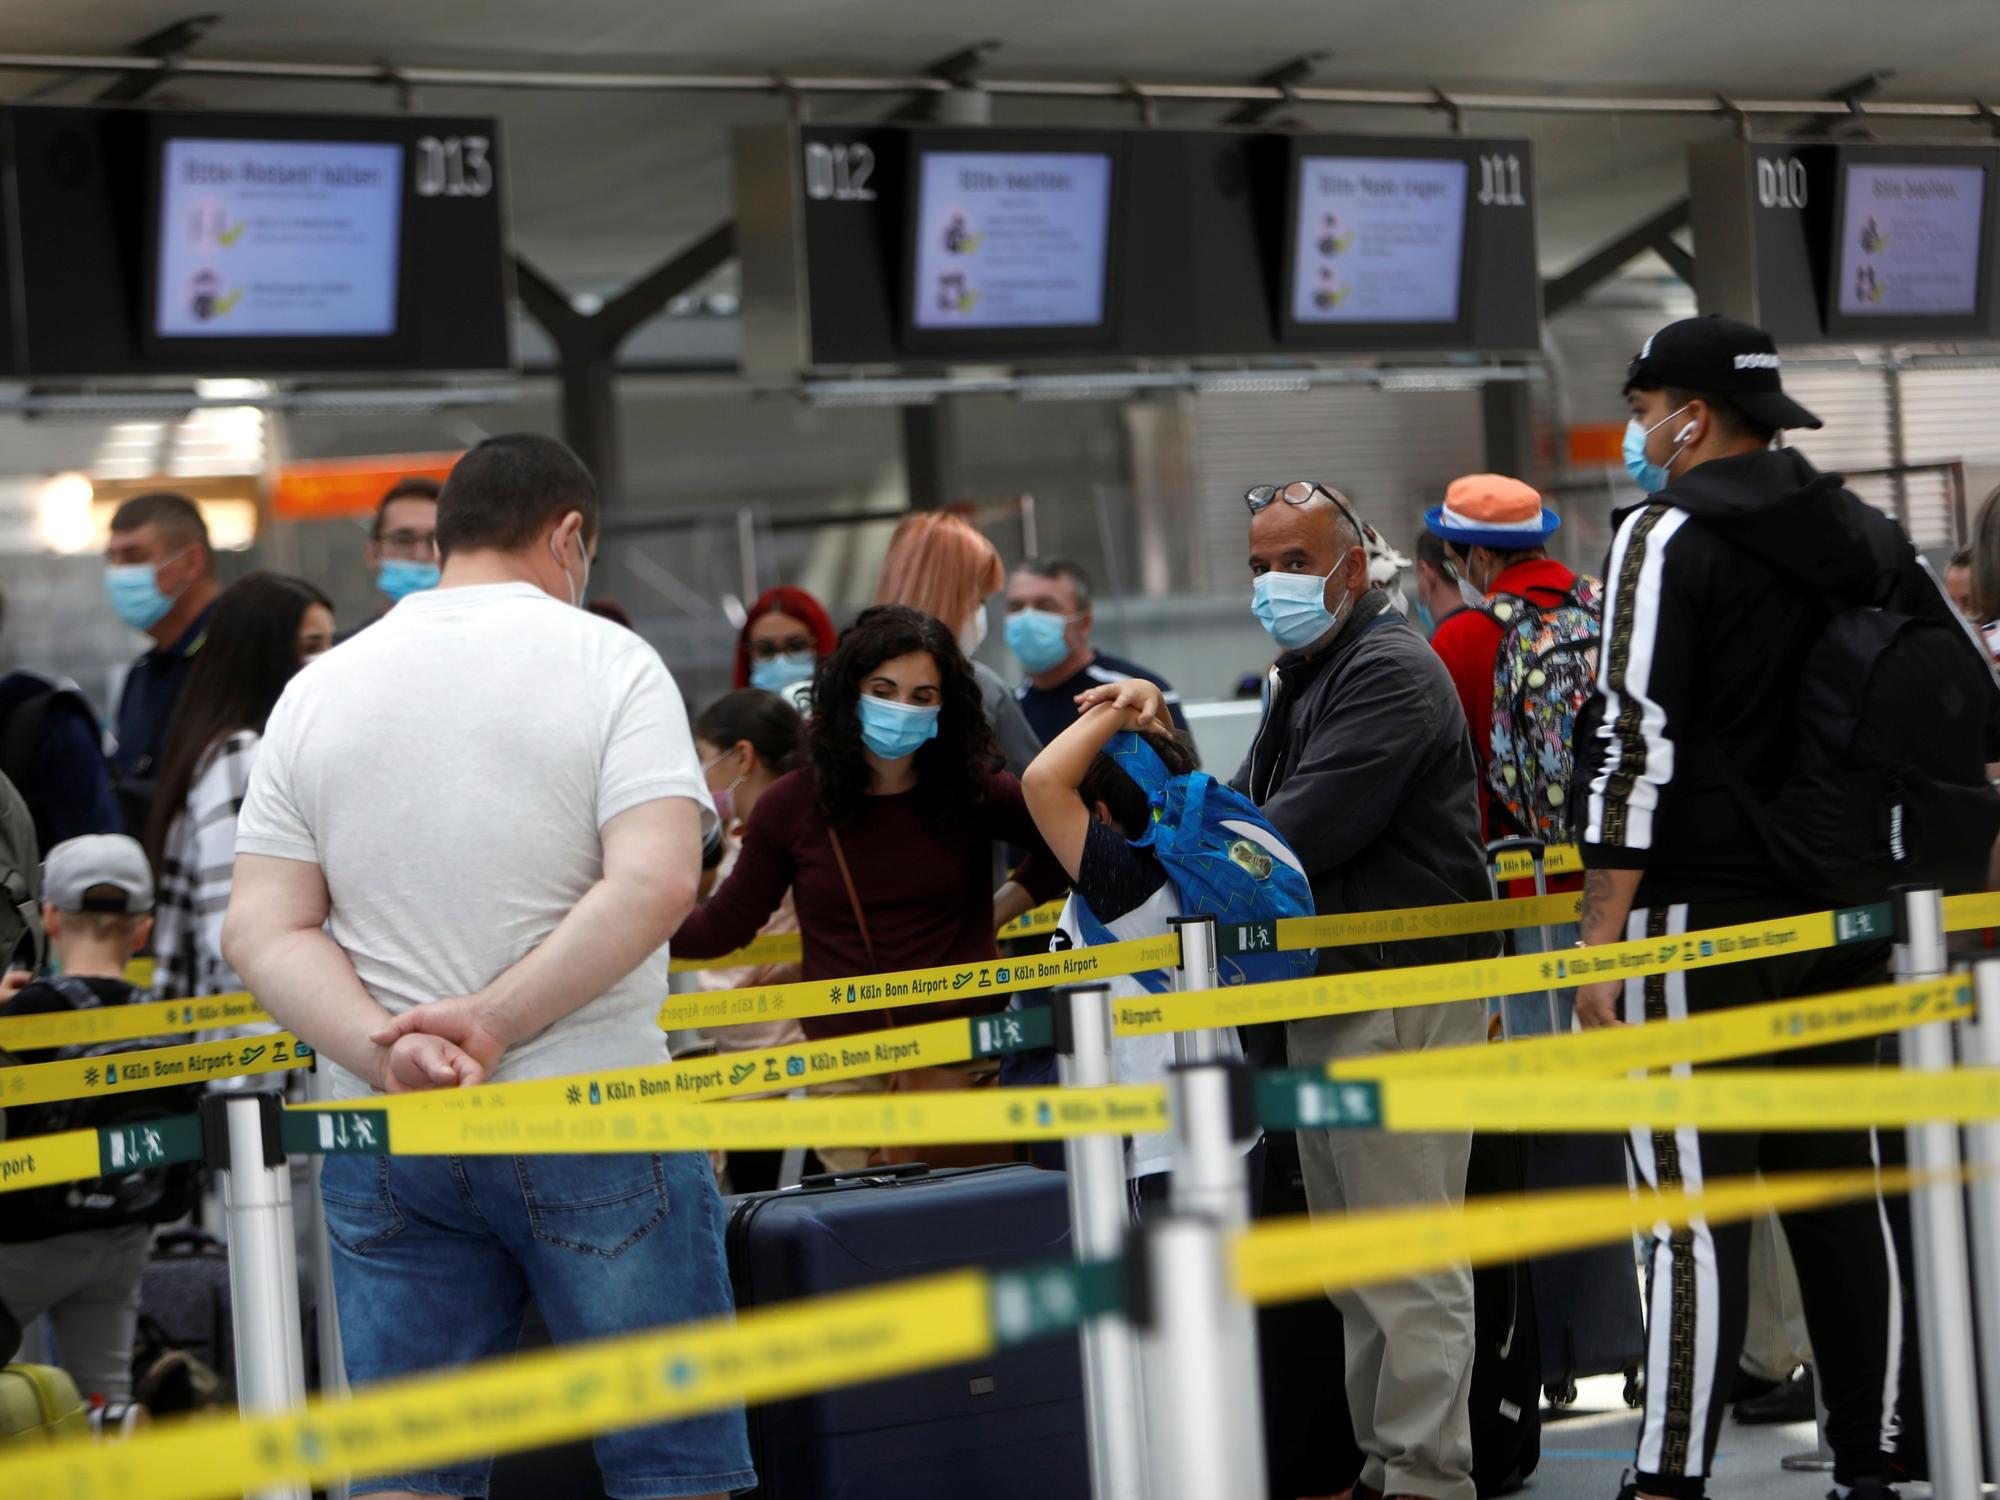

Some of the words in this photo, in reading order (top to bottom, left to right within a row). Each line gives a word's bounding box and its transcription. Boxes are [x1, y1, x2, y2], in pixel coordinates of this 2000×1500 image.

[415, 136, 493, 197] D13
[804, 141, 877, 200] D12
[1756, 157, 1808, 208] D10
[1014, 965, 1034, 981] Köln
[1038, 963, 1060, 977] Bonn
[1064, 956, 1098, 974] Airport
[860, 984, 882, 1000] Köln
[885, 982, 908, 997] Bonn
[912, 977, 948, 996] Airport
[1121, 1007, 1163, 1028] Airport
[123, 1063, 149, 1080] Köln
[154, 1060, 184, 1077] Bonn
[188, 1052, 234, 1073] Airport
[811, 1053, 838, 1072] Köln
[842, 1049, 871, 1067] Bonn
[875, 1040, 920, 1063] Airport
[606, 1081, 636, 1101] Köln
[640, 1077, 671, 1097] Bonn
[675, 1070, 723, 1093] Airport
